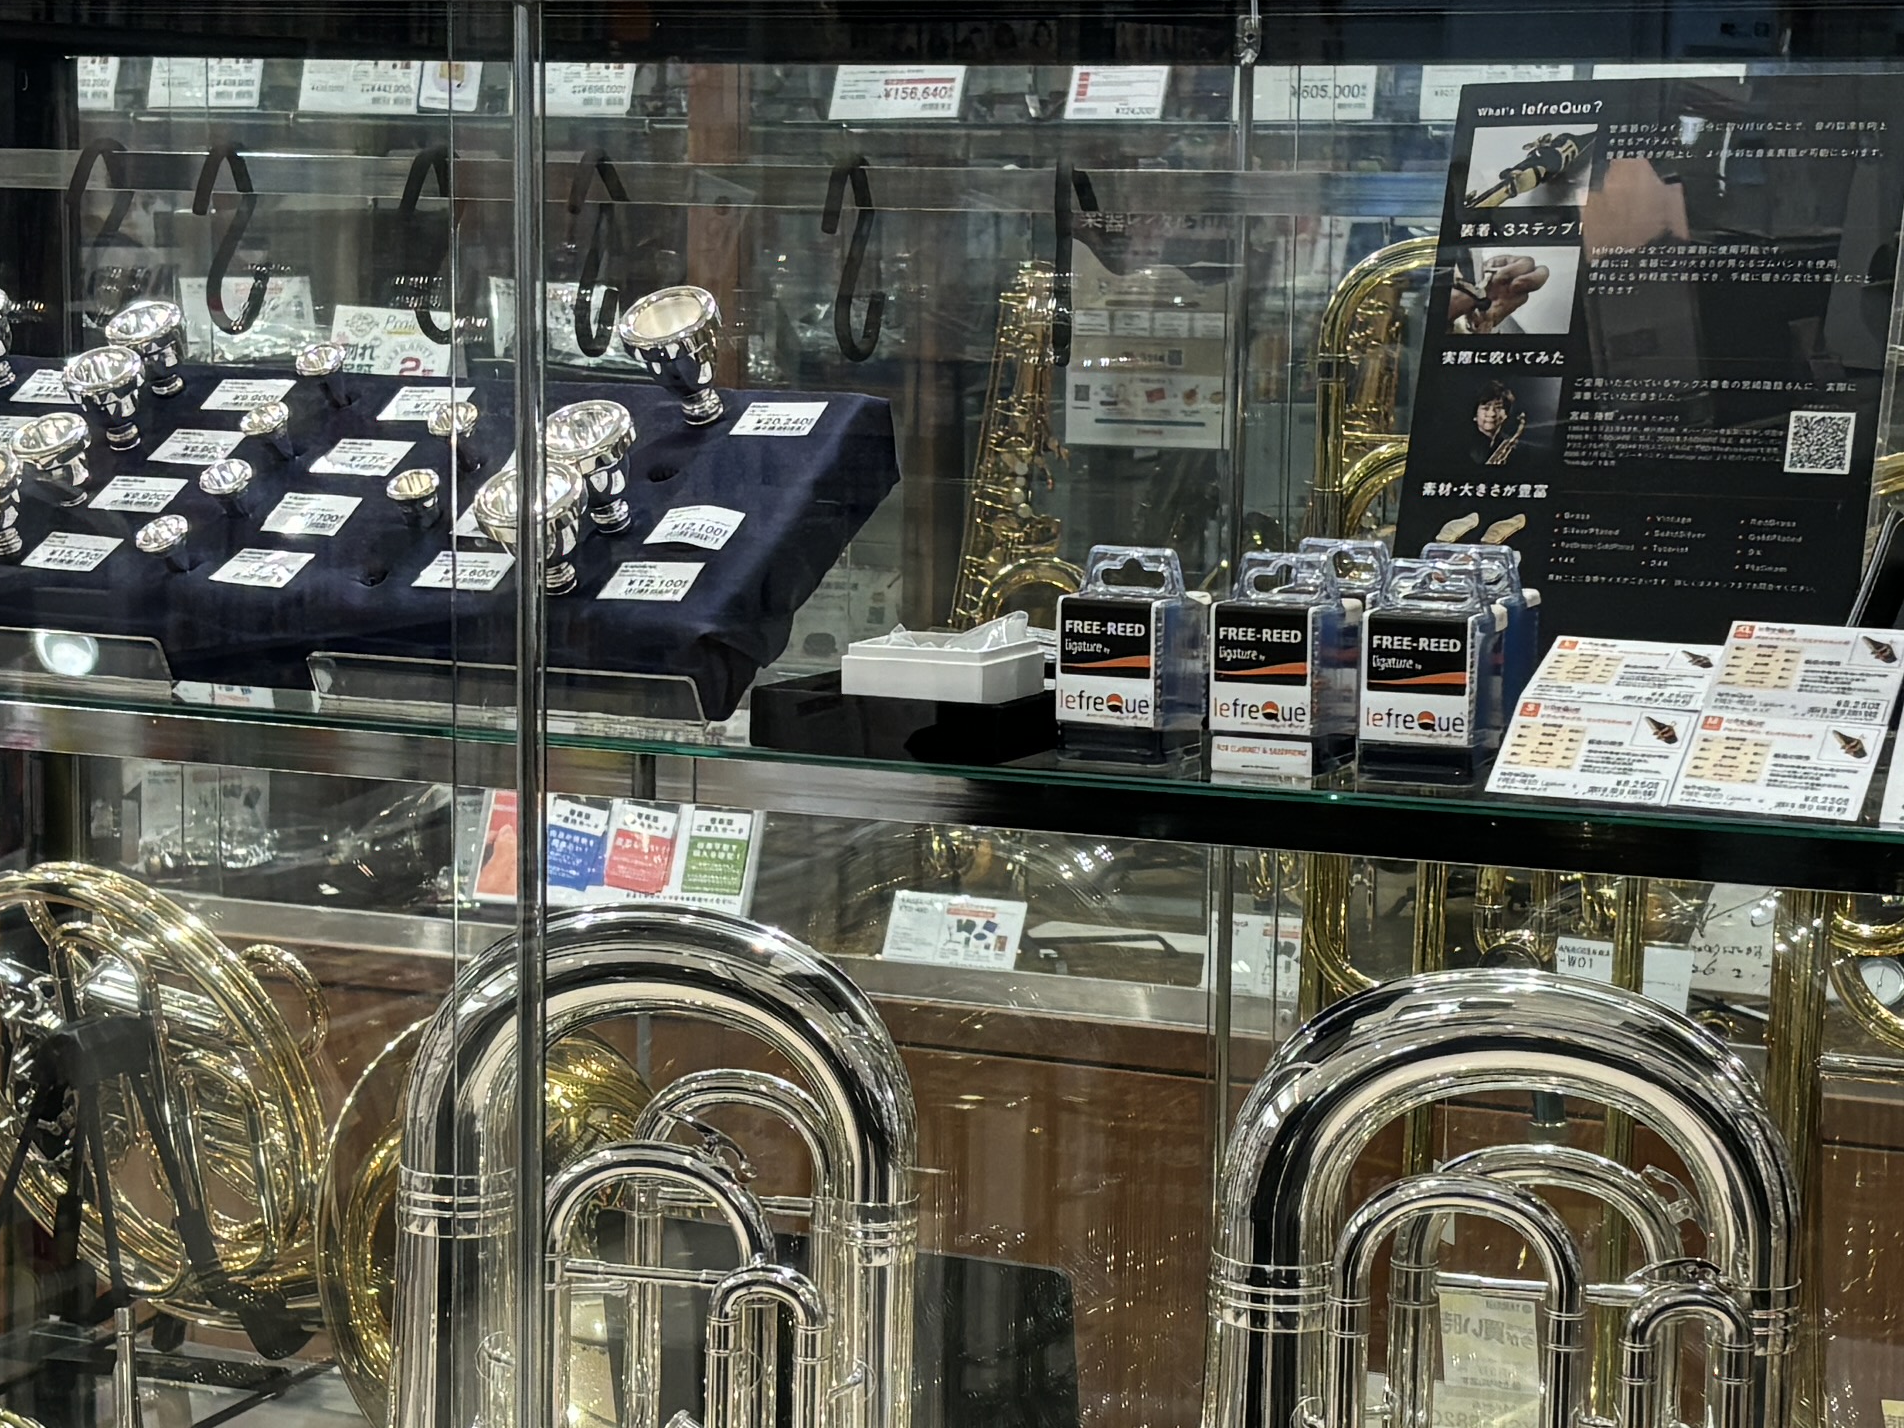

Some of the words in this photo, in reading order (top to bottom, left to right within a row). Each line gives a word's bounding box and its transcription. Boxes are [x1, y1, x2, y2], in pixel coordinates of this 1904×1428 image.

[1442, 350, 1565, 366] 実際に吹いてみた
[1422, 483, 1550, 499] 素材・大きさが豊富
[1065, 620, 1146, 638] FREE-REED
[1218, 627, 1302, 643] FREE-REED
[1372, 635, 1461, 653] FREE-REED
[1059, 689, 1151, 713] lefreQue
[1213, 696, 1307, 722] lefreQue
[1366, 707, 1466, 733] lefreQue
